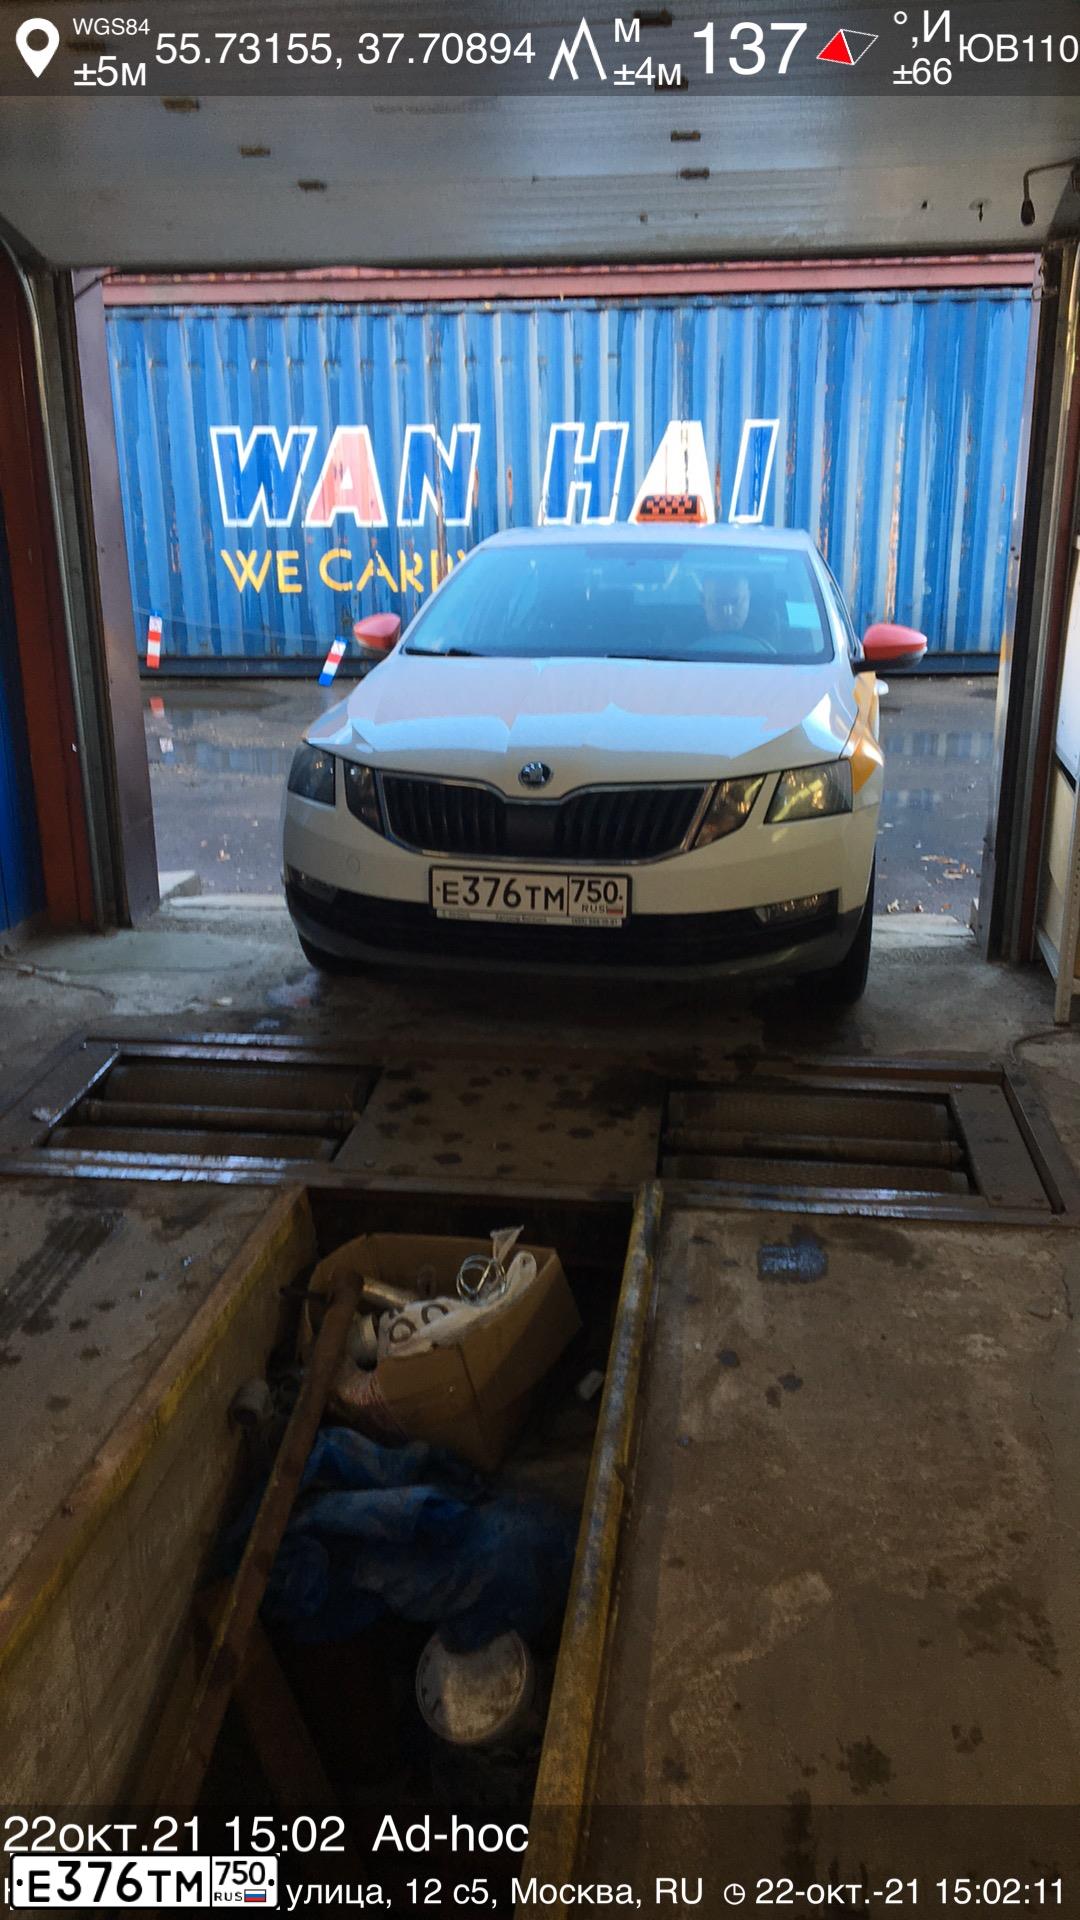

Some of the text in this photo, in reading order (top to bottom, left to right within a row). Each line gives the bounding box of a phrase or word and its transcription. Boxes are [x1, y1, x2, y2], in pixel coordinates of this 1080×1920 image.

[209, 418, 778, 528] WAN HAI
[220, 547, 466, 593] WE CAR
[571, 879, 619, 902] 750
[581, 903, 604, 913] RUS
